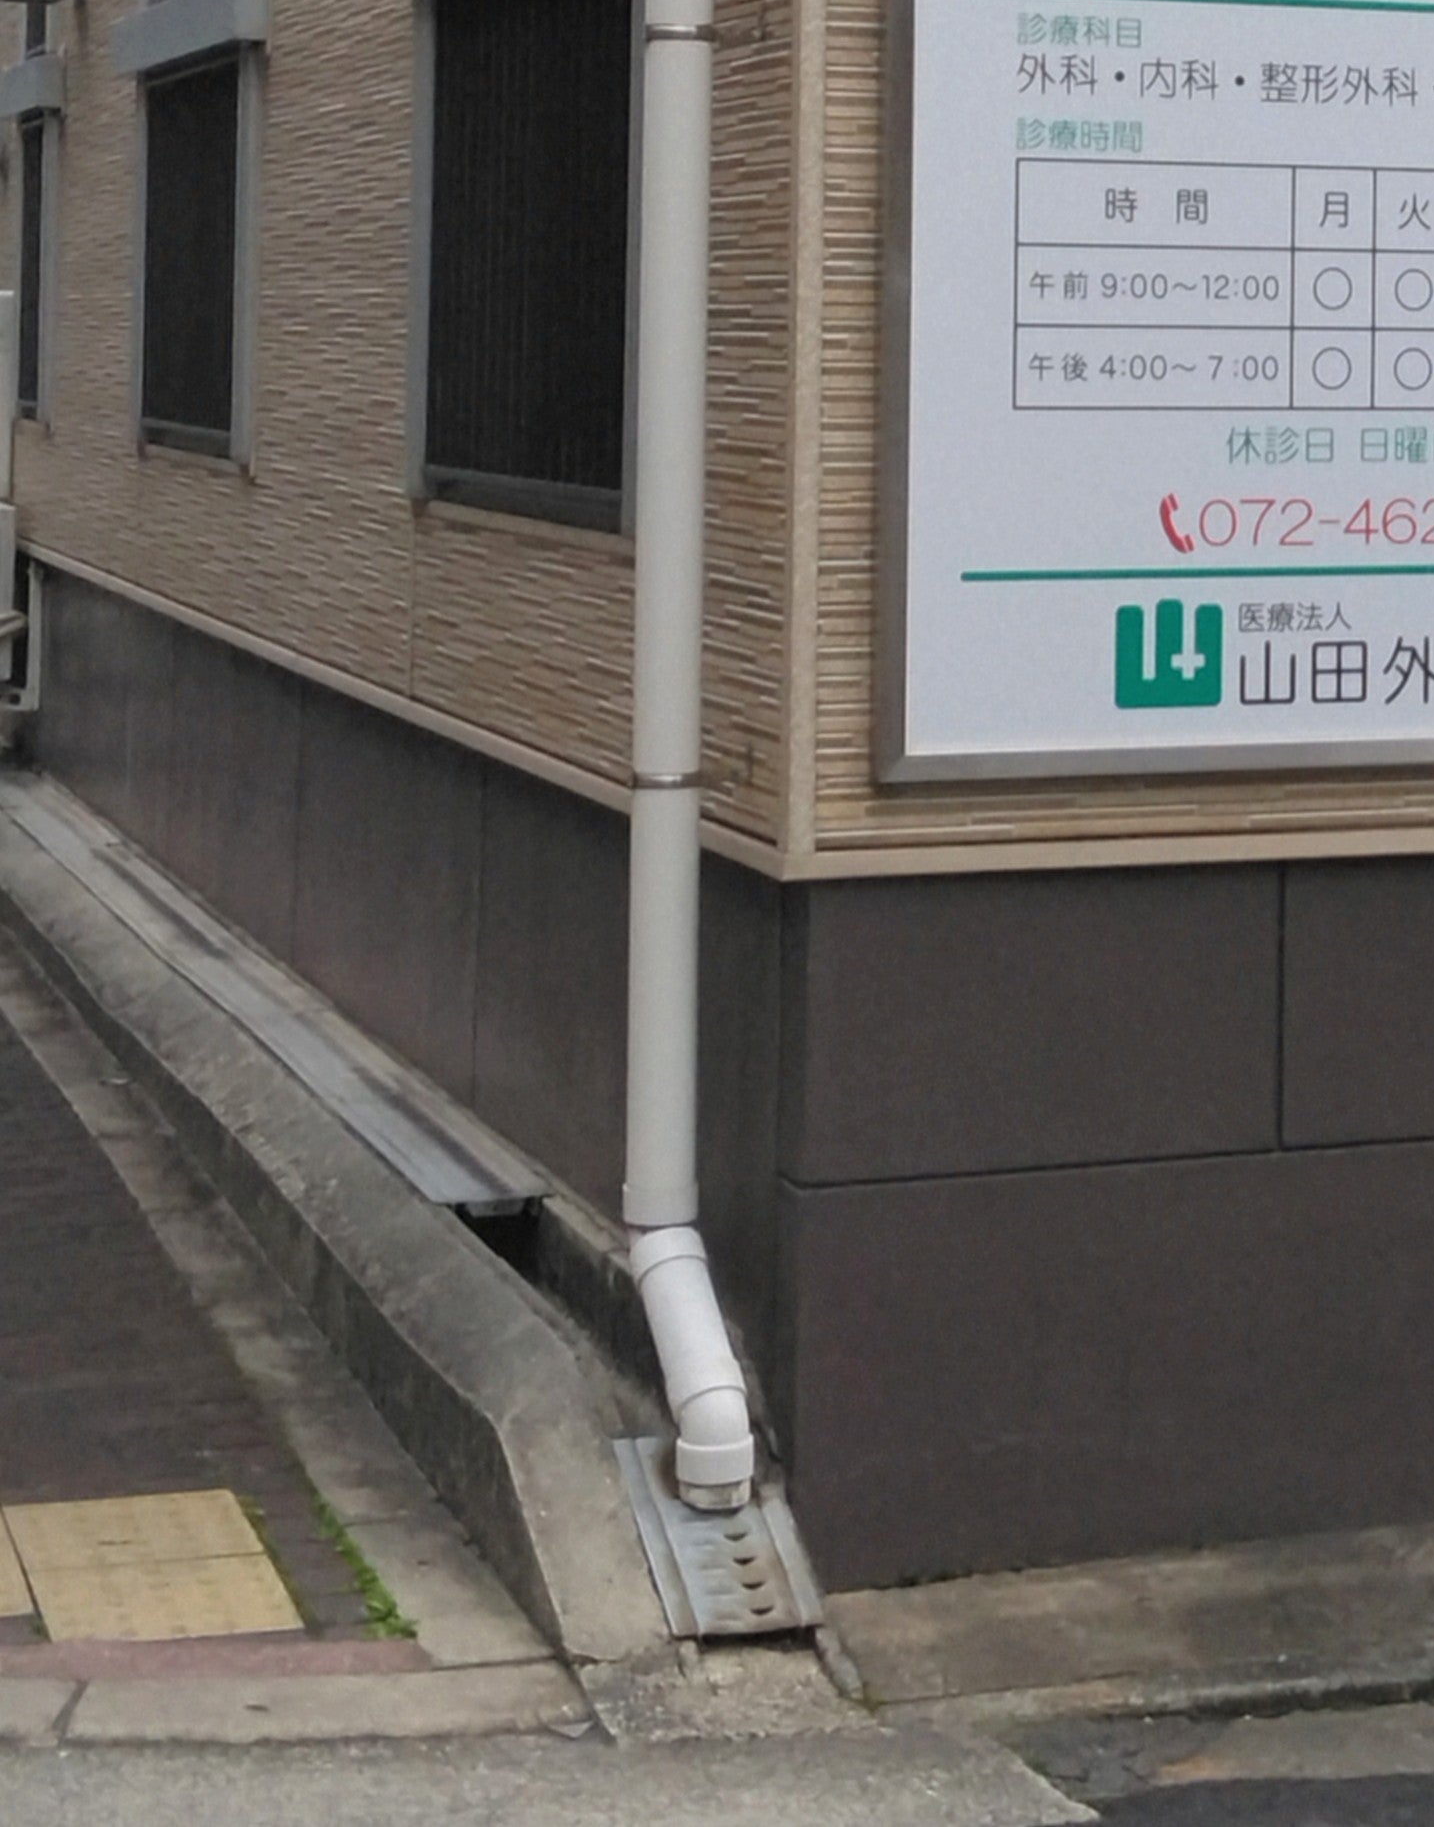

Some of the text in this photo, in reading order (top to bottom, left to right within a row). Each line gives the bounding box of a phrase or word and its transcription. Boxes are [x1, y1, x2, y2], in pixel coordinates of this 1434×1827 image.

[1016, 11, 1143, 49] 診療科目
[1015, 116, 1143, 153] 診療時間
[1103, 187, 1210, 226] 時間
[1319, 191, 1350, 229] 月
[1397, 193, 1432, 231] 火
[1226, 425, 1335, 465] 休診日
[1238, 601, 1353, 633] 医療法人
